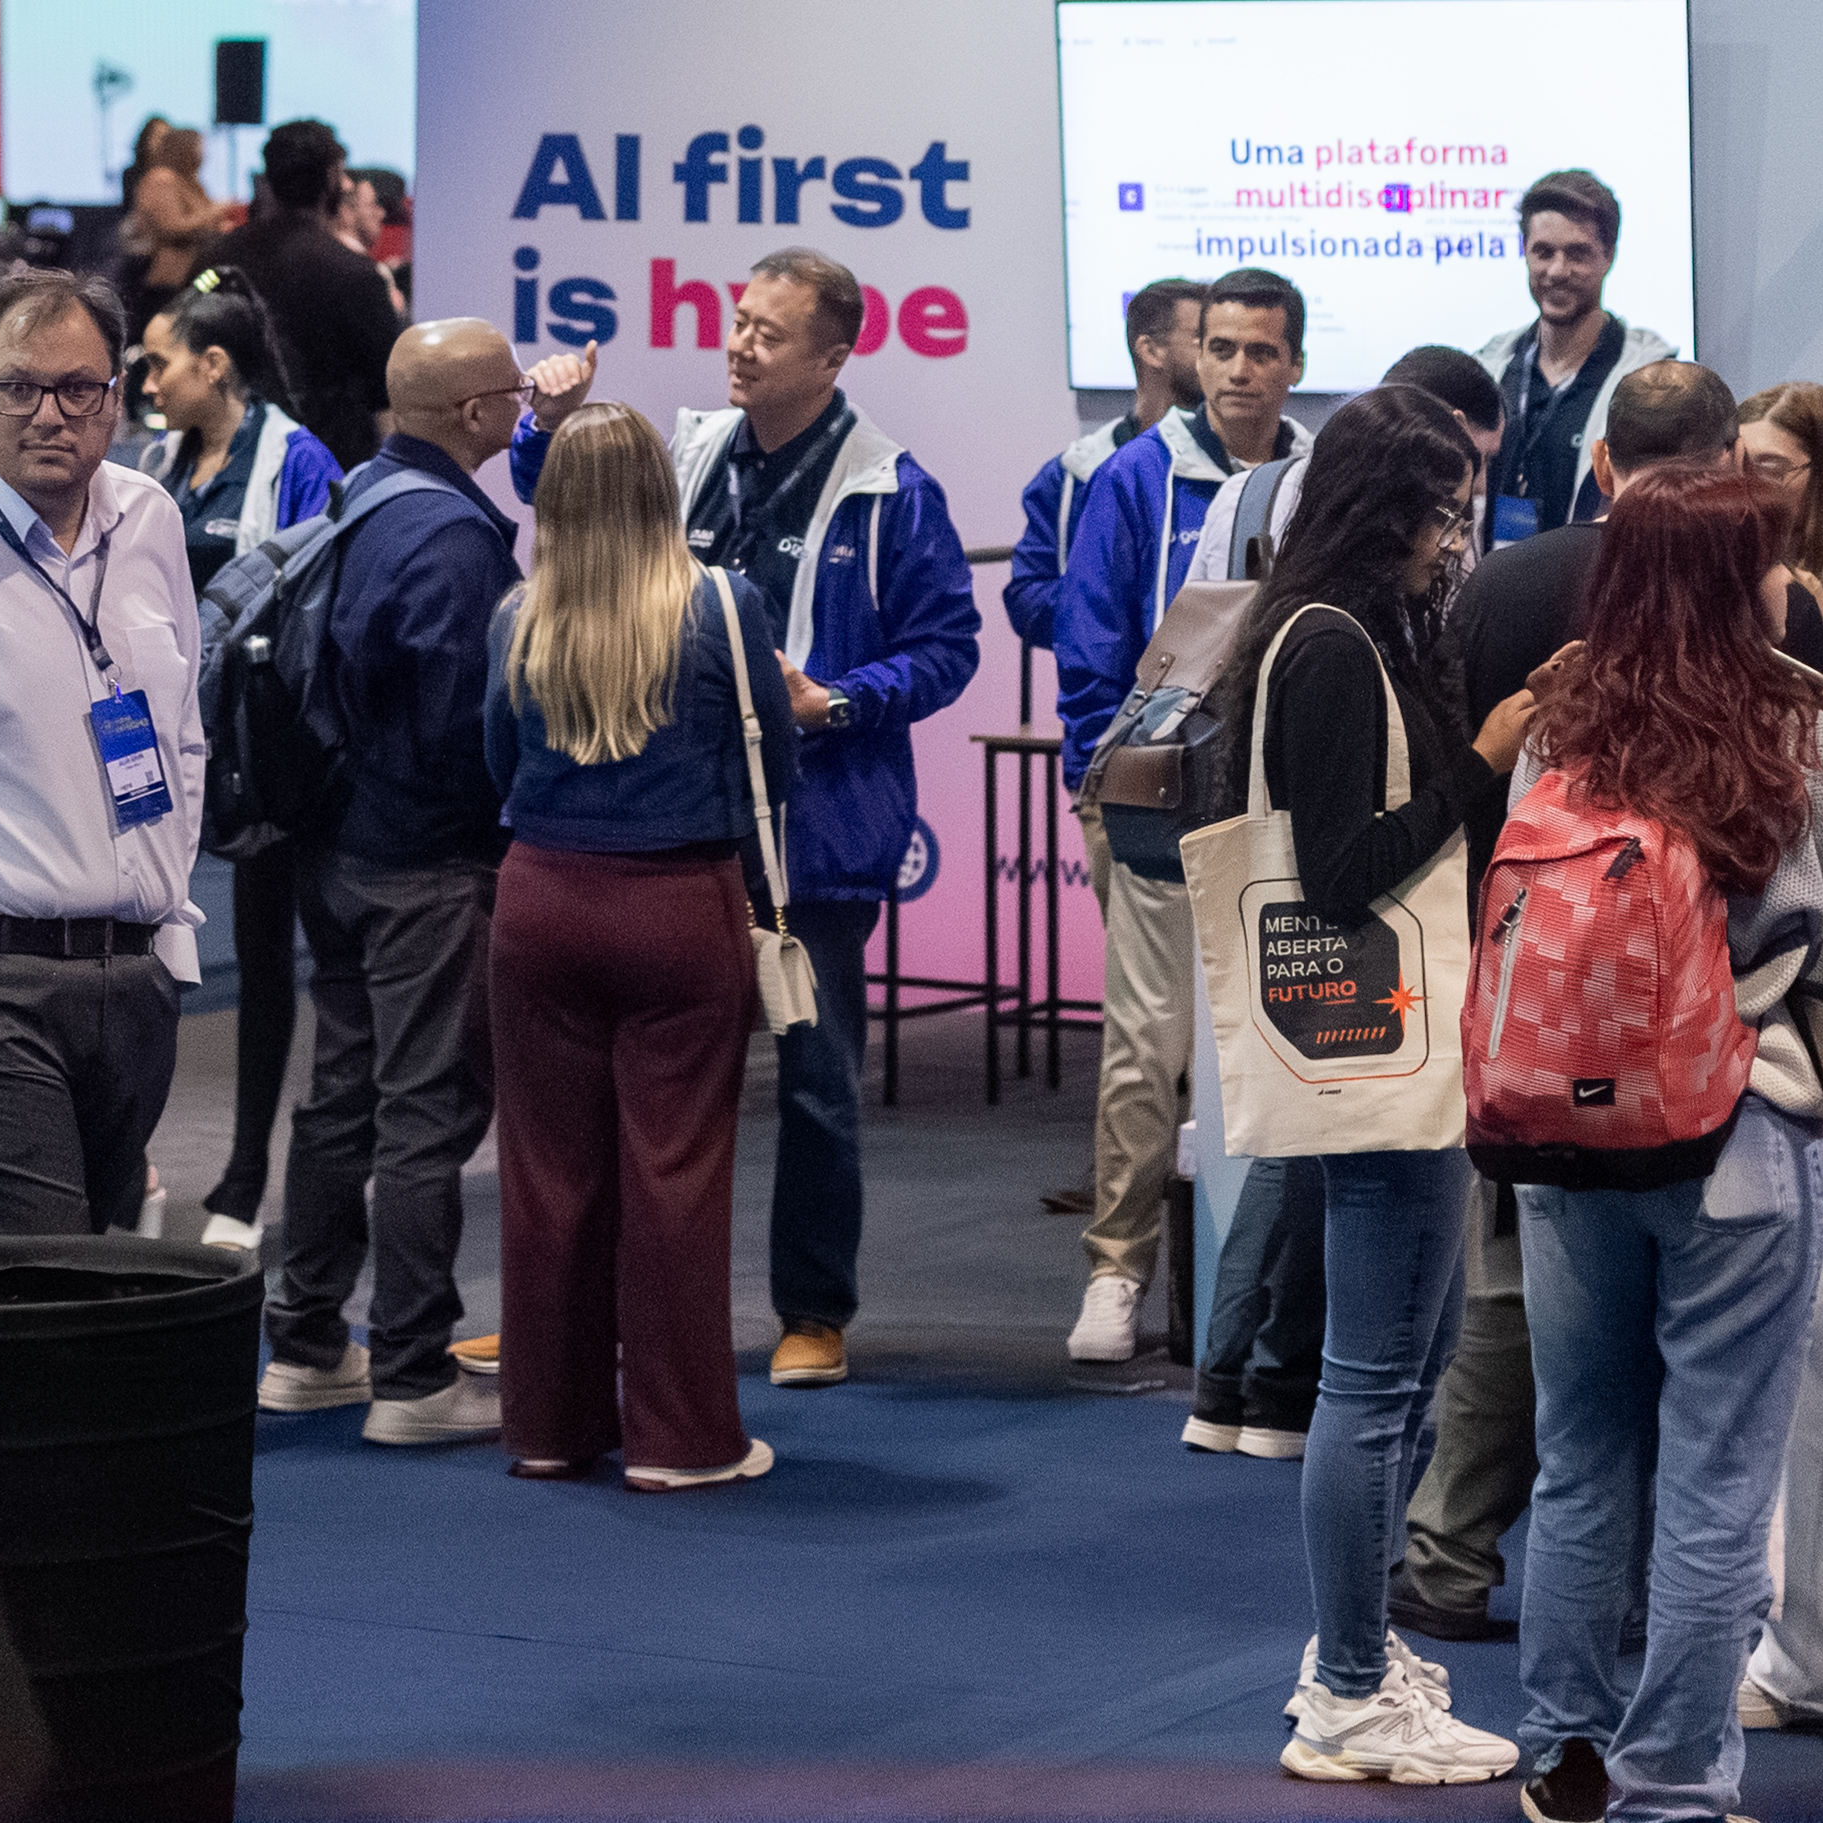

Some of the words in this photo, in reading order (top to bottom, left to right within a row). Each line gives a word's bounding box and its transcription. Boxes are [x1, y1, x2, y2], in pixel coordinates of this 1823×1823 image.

[1230, 138, 1304, 165] Uma
[1316, 137, 1508, 171] plataforma
[511, 132, 641, 221] AI
[673, 124, 971, 230] first
[1235, 180, 1507, 214] multidisciplinar
[1196, 228, 1423, 263] impulsionada
[1436, 229, 1506, 265] pela
[513, 246, 618, 348] is
[1266, 936, 1348, 957] ABERTA
[1267, 960, 1322, 980] PARA
[1327, 957, 1344, 974] O
[1268, 980, 1357, 1003] FUTURO
